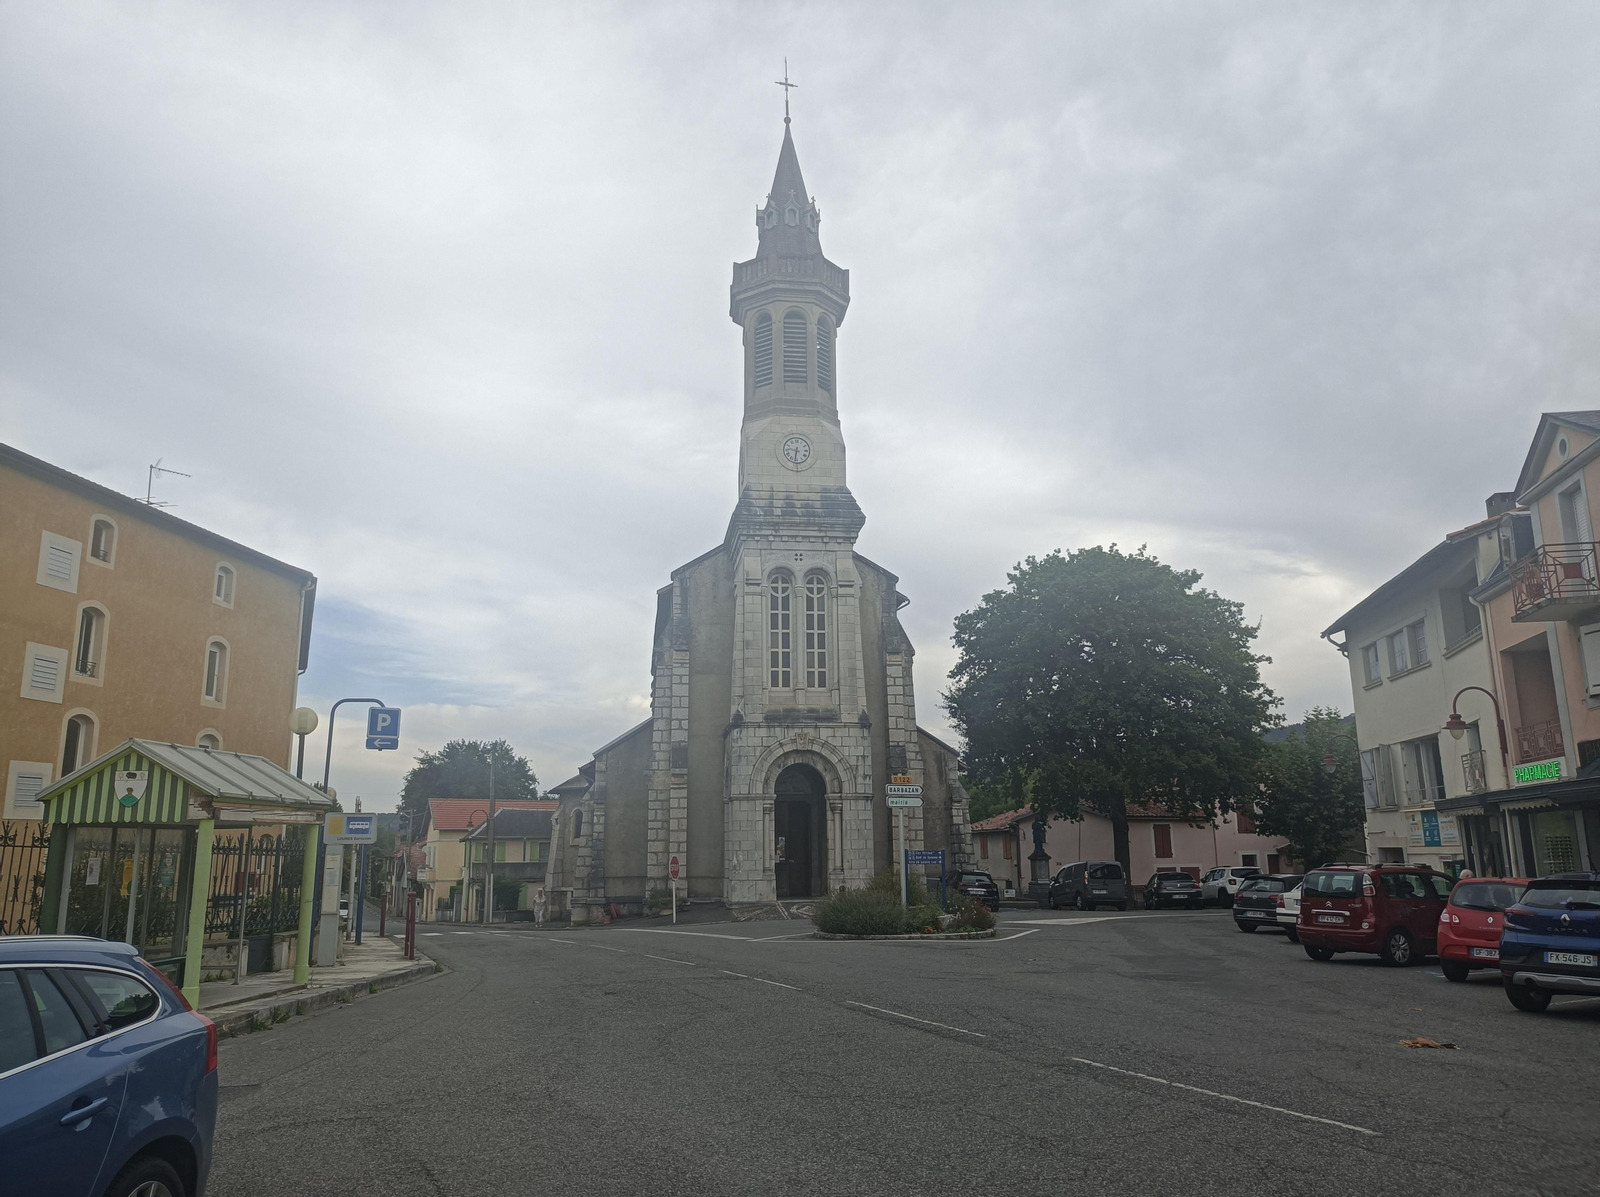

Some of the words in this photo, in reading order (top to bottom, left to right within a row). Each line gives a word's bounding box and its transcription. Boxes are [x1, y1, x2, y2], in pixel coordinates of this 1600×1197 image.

[377, 713, 392, 732] P
[1514, 761, 1560, 783] PHARMACIE
[1549, 953, 1592, 964] FX-546-JS
